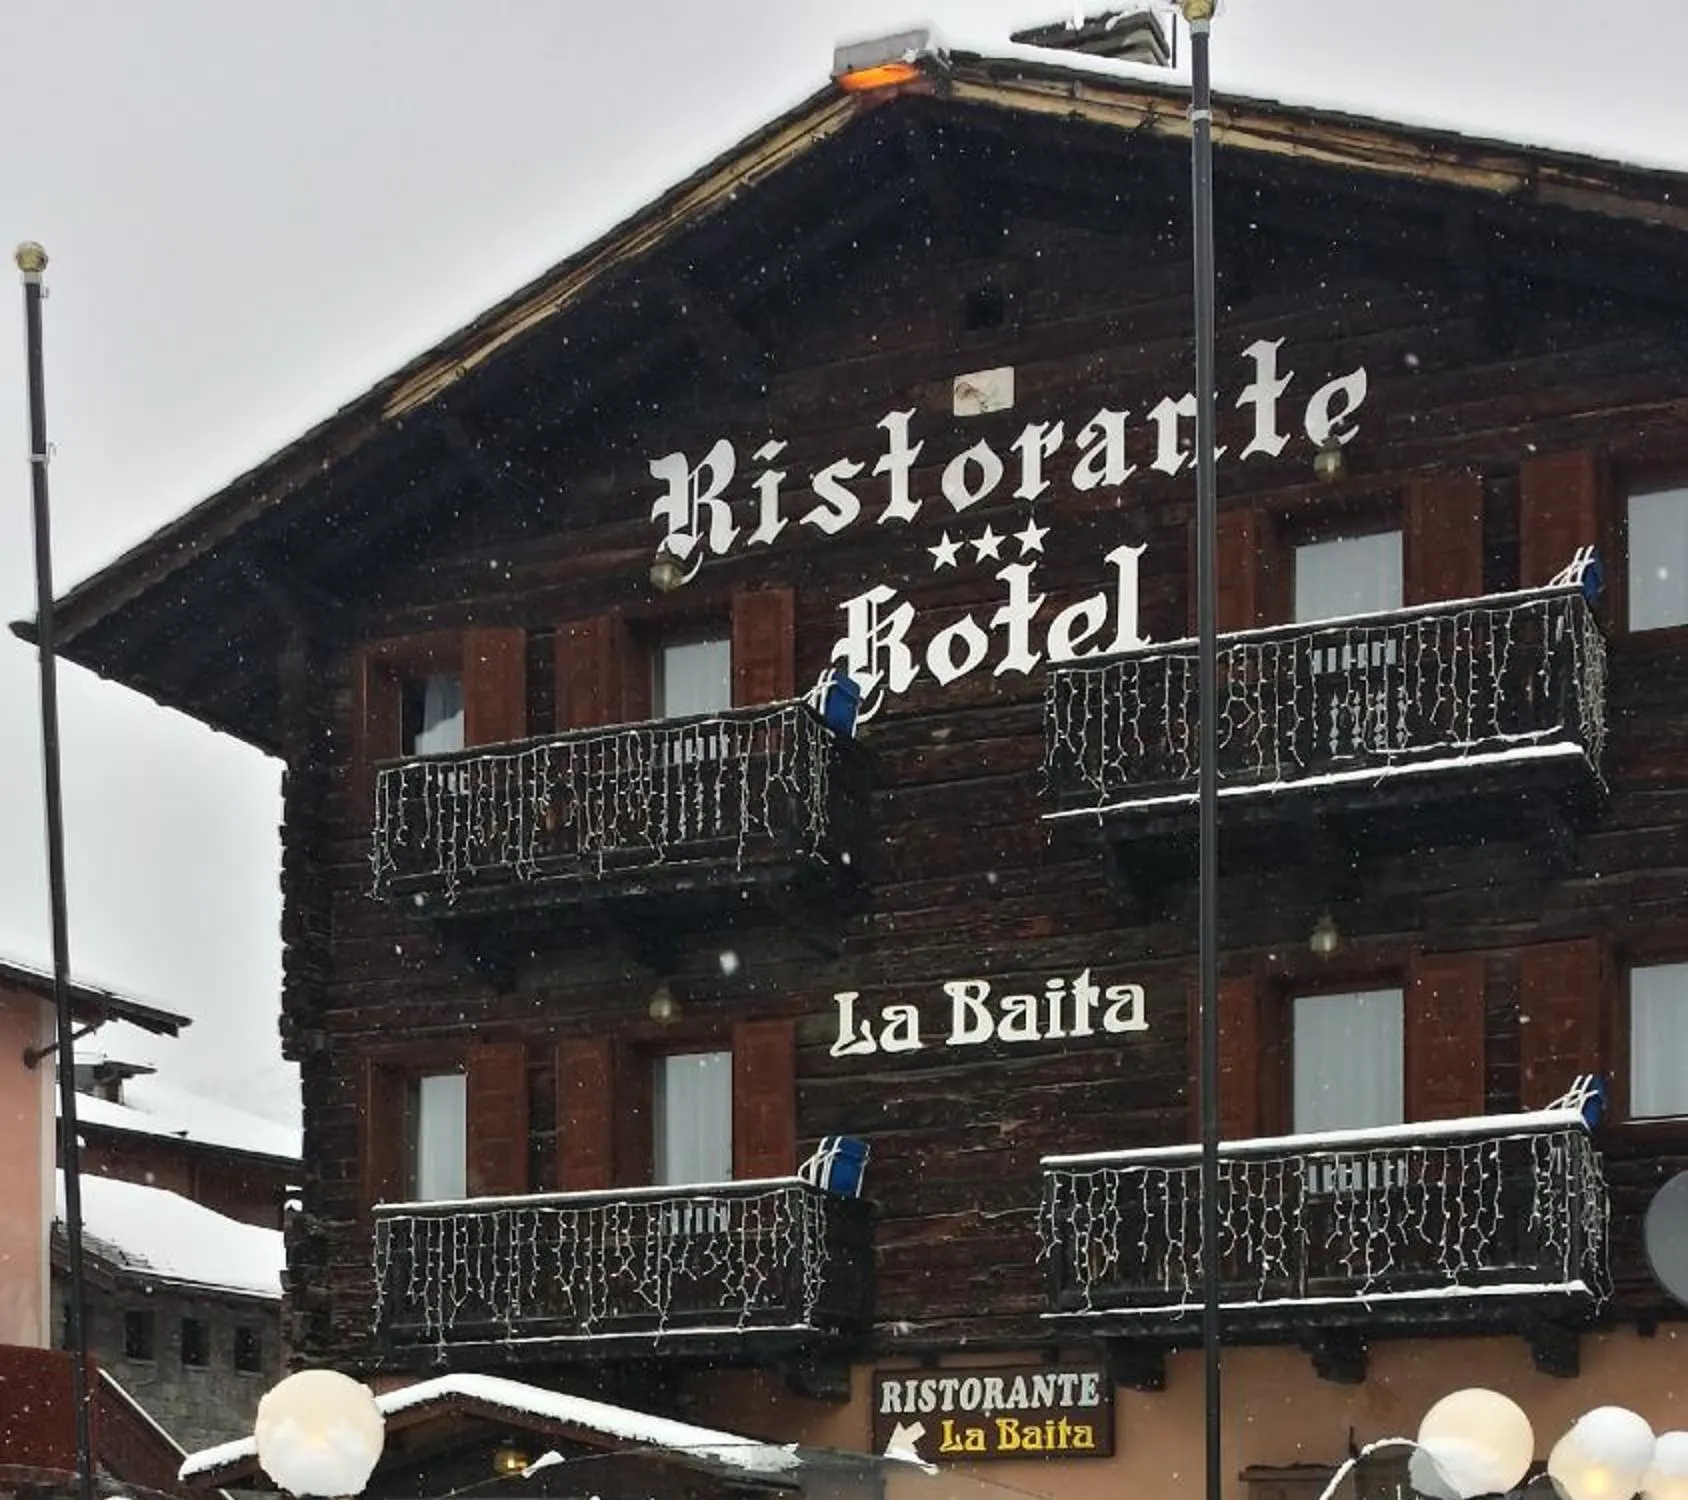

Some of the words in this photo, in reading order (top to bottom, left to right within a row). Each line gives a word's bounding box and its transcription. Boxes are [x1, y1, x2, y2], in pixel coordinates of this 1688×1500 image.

[649, 337, 1368, 584] Ristorante
[831, 542, 1151, 725] Hotel
[829, 991, 924, 1057] La
[943, 968, 1150, 1046] Baita
[880, 1372, 1100, 1413] RISTORANTE
[940, 1419, 987, 1453] La
[996, 1415, 1096, 1450] Baita
